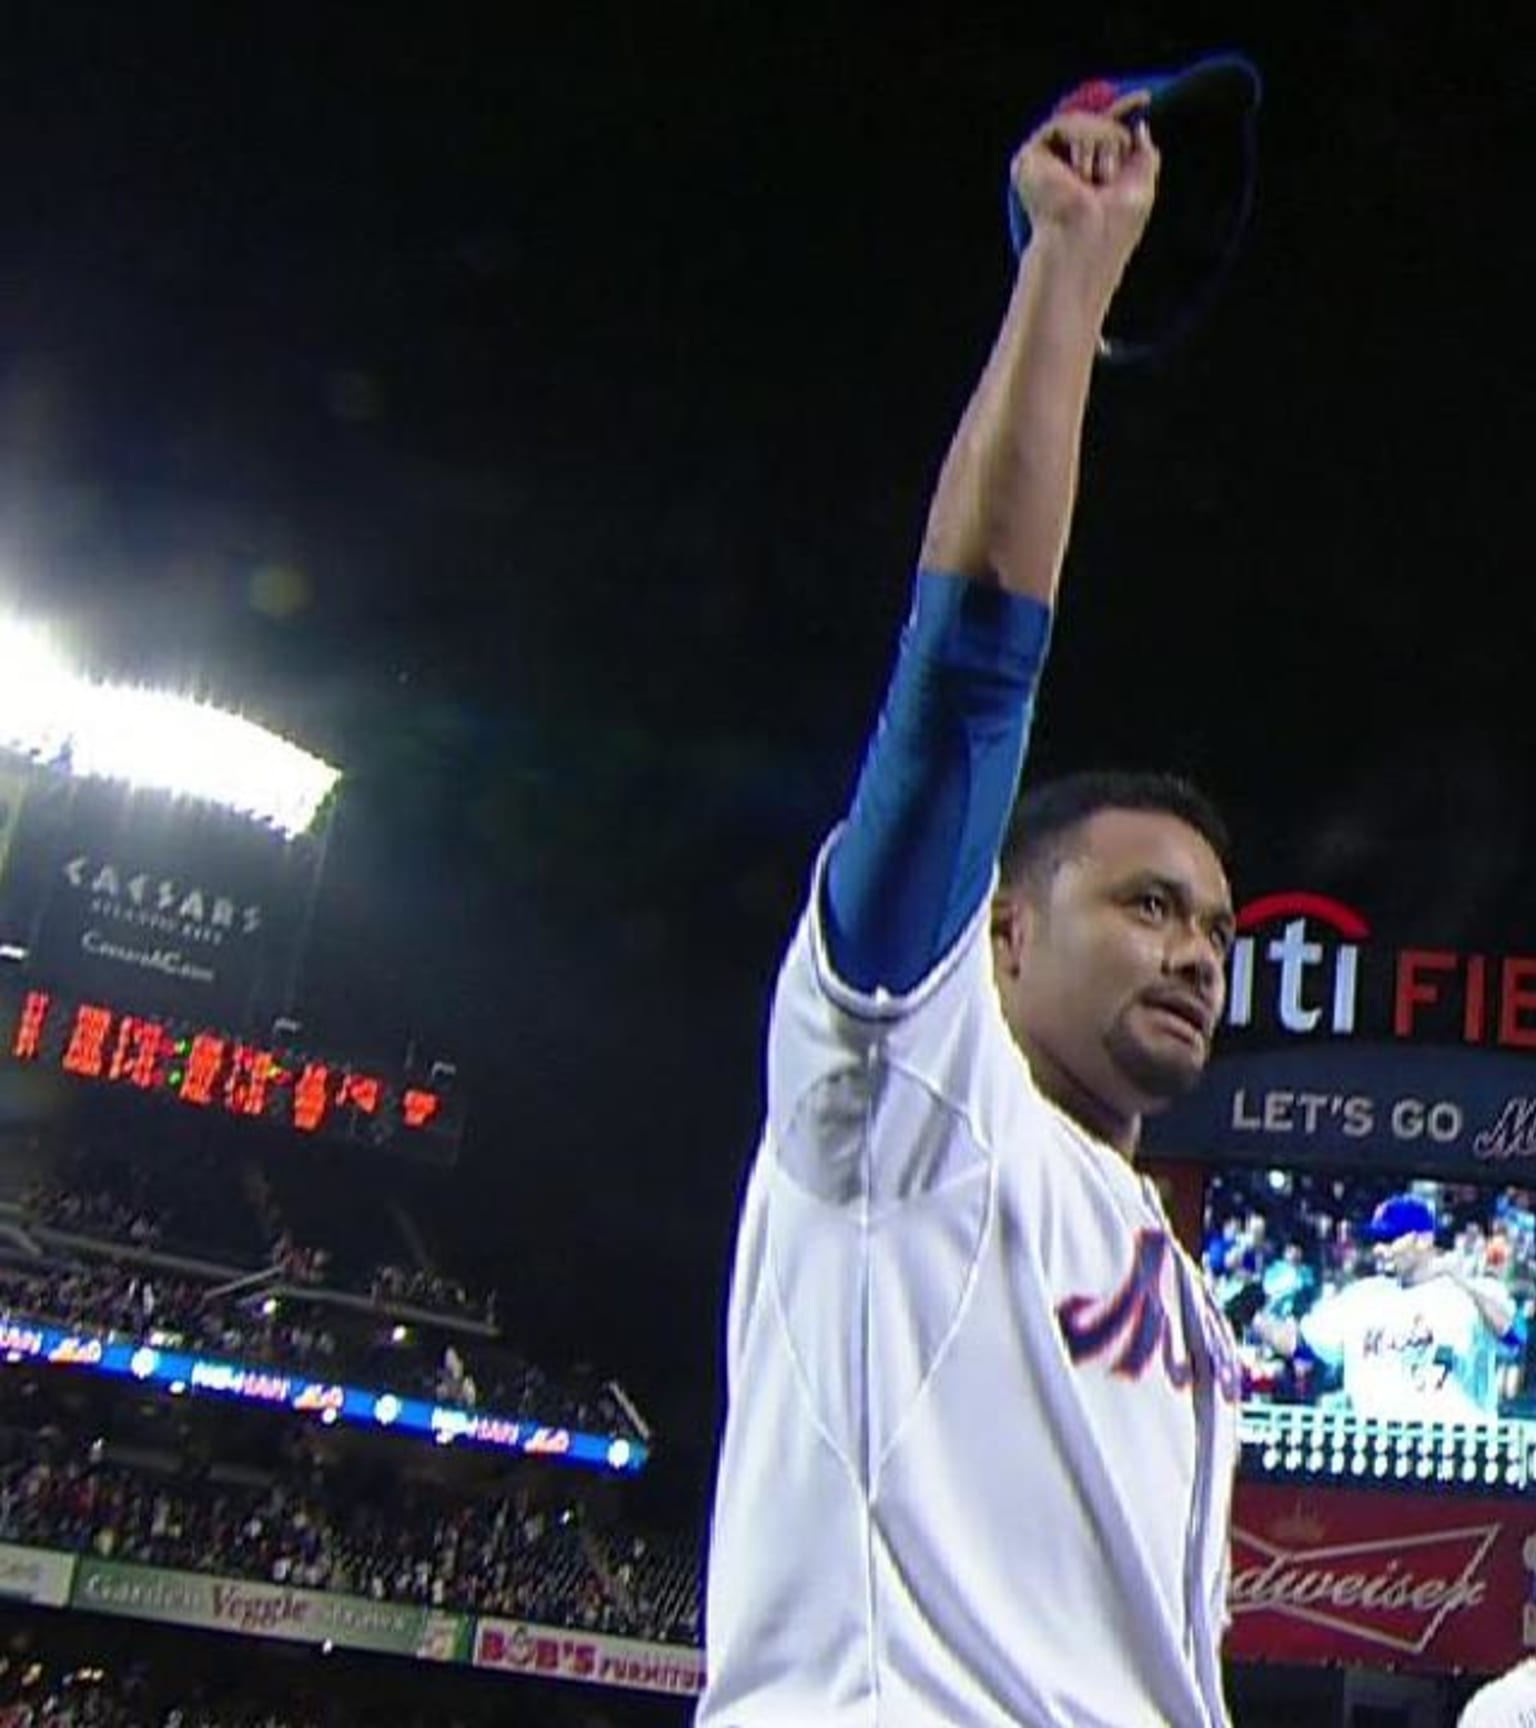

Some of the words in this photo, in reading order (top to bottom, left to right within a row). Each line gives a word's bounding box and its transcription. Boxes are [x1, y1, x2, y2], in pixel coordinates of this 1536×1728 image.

[64, 857, 262, 934] CAESARS
[1229, 915, 1360, 1035] iti
[1231, 1089, 1375, 1138] LET'S
[1391, 1098, 1465, 1144] GO
[212, 1583, 309, 1630] Veggie
[1231, 1556, 1487, 1611] dweiser
[479, 1627, 599, 1677] BOB'S
